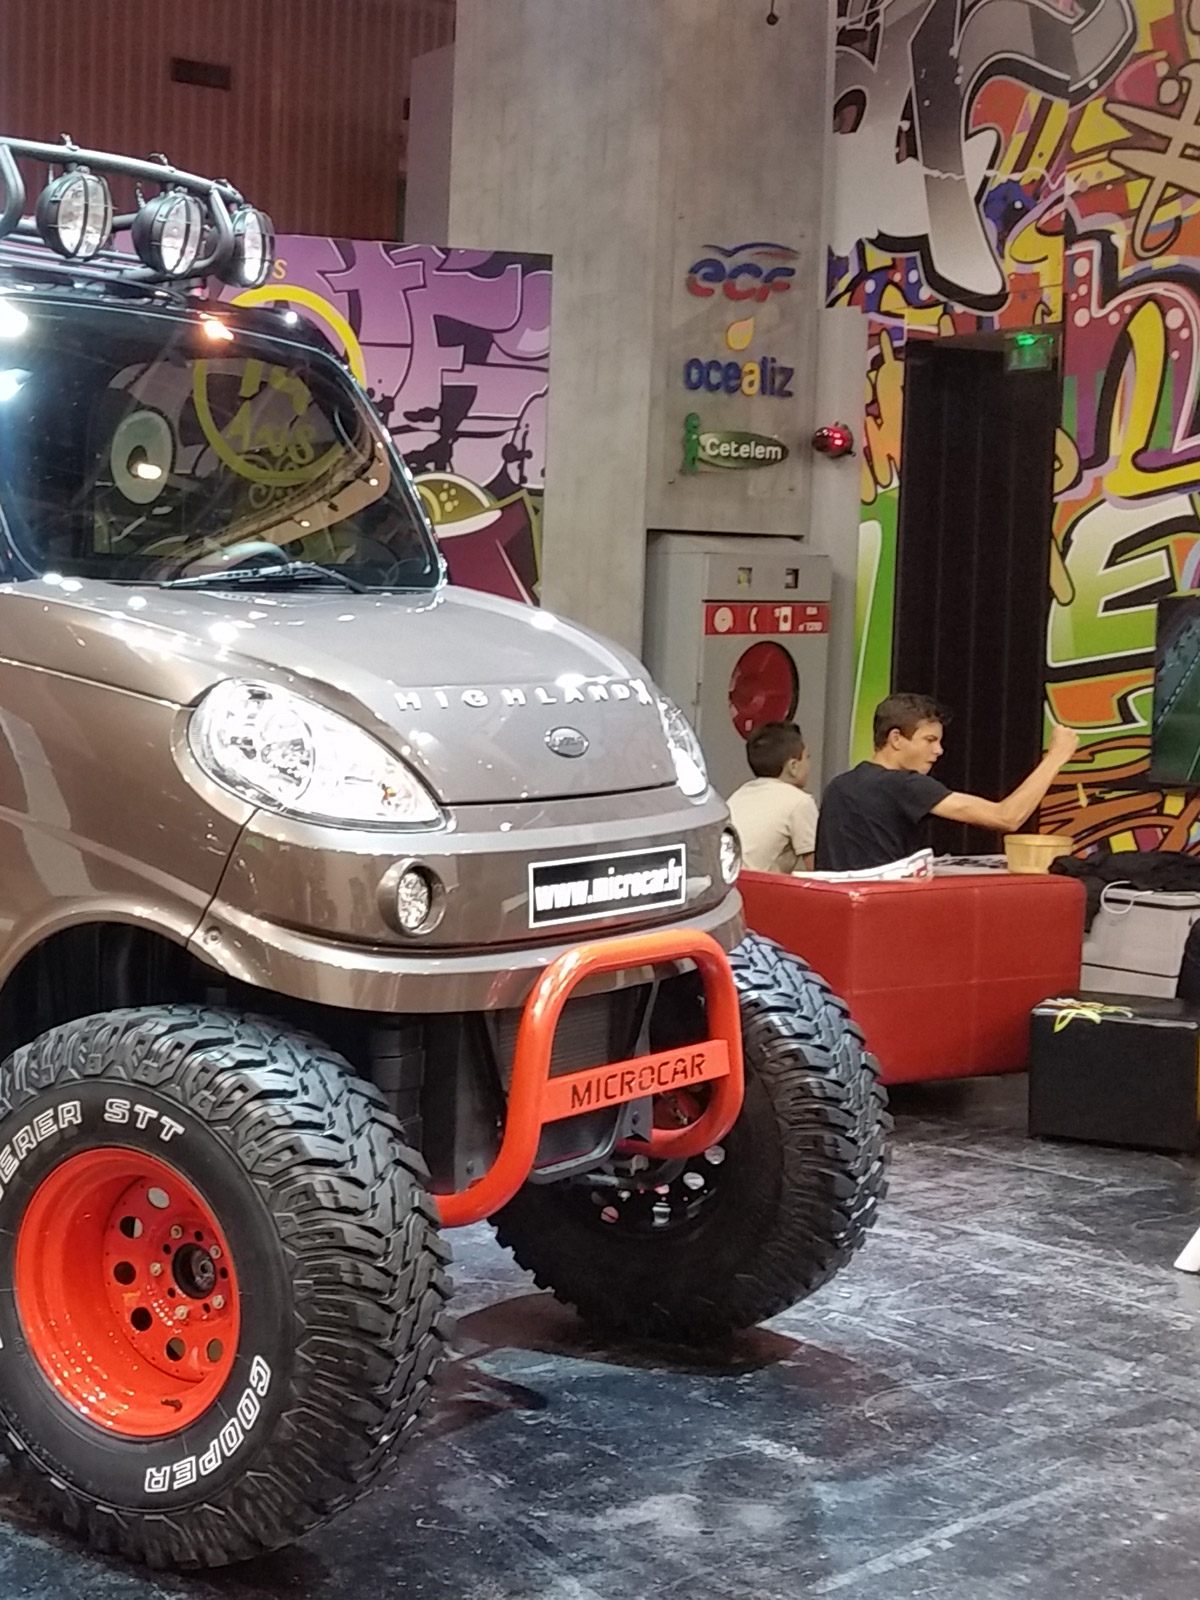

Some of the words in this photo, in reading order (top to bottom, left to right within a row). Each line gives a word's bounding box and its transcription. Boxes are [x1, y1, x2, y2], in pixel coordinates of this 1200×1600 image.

[684, 356, 795, 398] ocealiz
[705, 437, 782, 461] Cetelem
[535, 858, 683, 911] www.microcar.fr
[570, 1053, 706, 1110] MICROCAR
[103, 1098, 186, 1143] STT
[143, 1356, 272, 1493] COOPER
